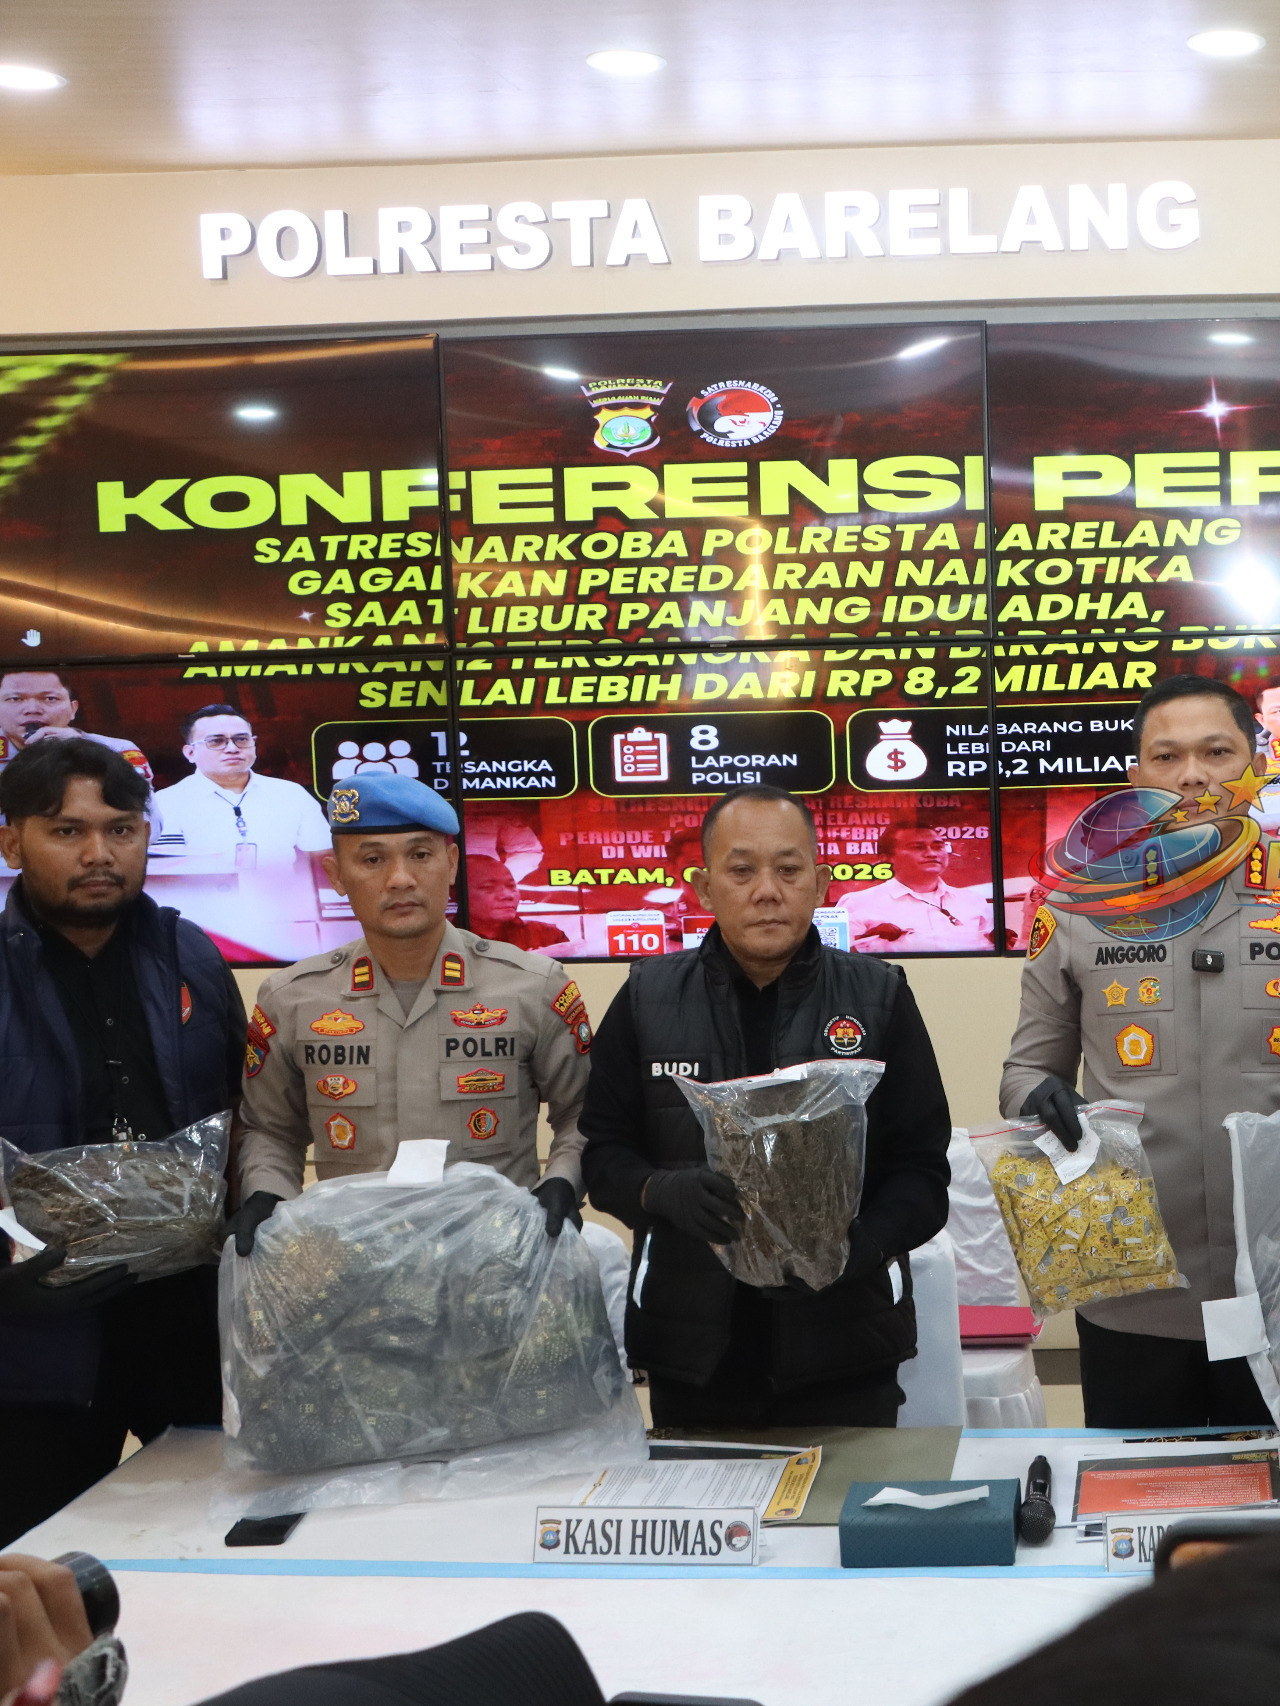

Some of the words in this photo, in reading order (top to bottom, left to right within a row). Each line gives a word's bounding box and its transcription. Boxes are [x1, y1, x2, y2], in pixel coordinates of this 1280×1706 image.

[200, 197, 670, 281] POLRESTA
[698, 179, 1201, 264] BARELANG
[96, 454, 986, 533] KONFERENSI
[253, 529, 689, 564] SATRESNARKOBA
[701, 522, 961, 557] POLRESTA
[577, 559, 885, 596] PEREDARAN
[466, 602, 608, 635] LIBUR
[616, 595, 871, 630] PANJANG
[881, 593, 988, 623] IDUL
[997, 590, 1165, 623] ADHA,
[823, 630, 941, 662] DAN
[358, 677, 536, 708] SENLAI
[544, 673, 683, 705] LEBIH
[691, 670, 816, 701] DARI
[826, 668, 893, 697] RP
[903, 665, 982, 699] 8,2
[995, 660, 1157, 693] MILIAR
[689, 724, 720, 751] 8
[945, 724, 989, 736] NILA
[996, 720, 1083, 735] BARANG
[1089, 718, 1135, 732] BUK
[946, 742, 989, 754] LEBI
[1001, 739, 1050, 753] DARI
[432, 759, 553, 774] TESANGKA
[691, 754, 798, 769] LAPORAN
[947, 760, 988, 777] RP
[433, 776, 556, 790] DMANKAN
[692, 771, 761, 784] POLISI
[559, 829, 655, 846] PERIODE
[602, 845, 625, 859] DI
[549, 867, 675, 887] BATAM,
[829, 863, 893, 881] 026
[612, 933, 660, 951] 110
[1095, 944, 1167, 965] ANGGORO
[304, 1043, 370, 1065] ROBIN
[445, 1036, 515, 1058] POLRI
[651, 1062, 699, 1078] BUDI
[563, 1518, 623, 1556] KASI
[628, 1518, 723, 1556] HUMAS
